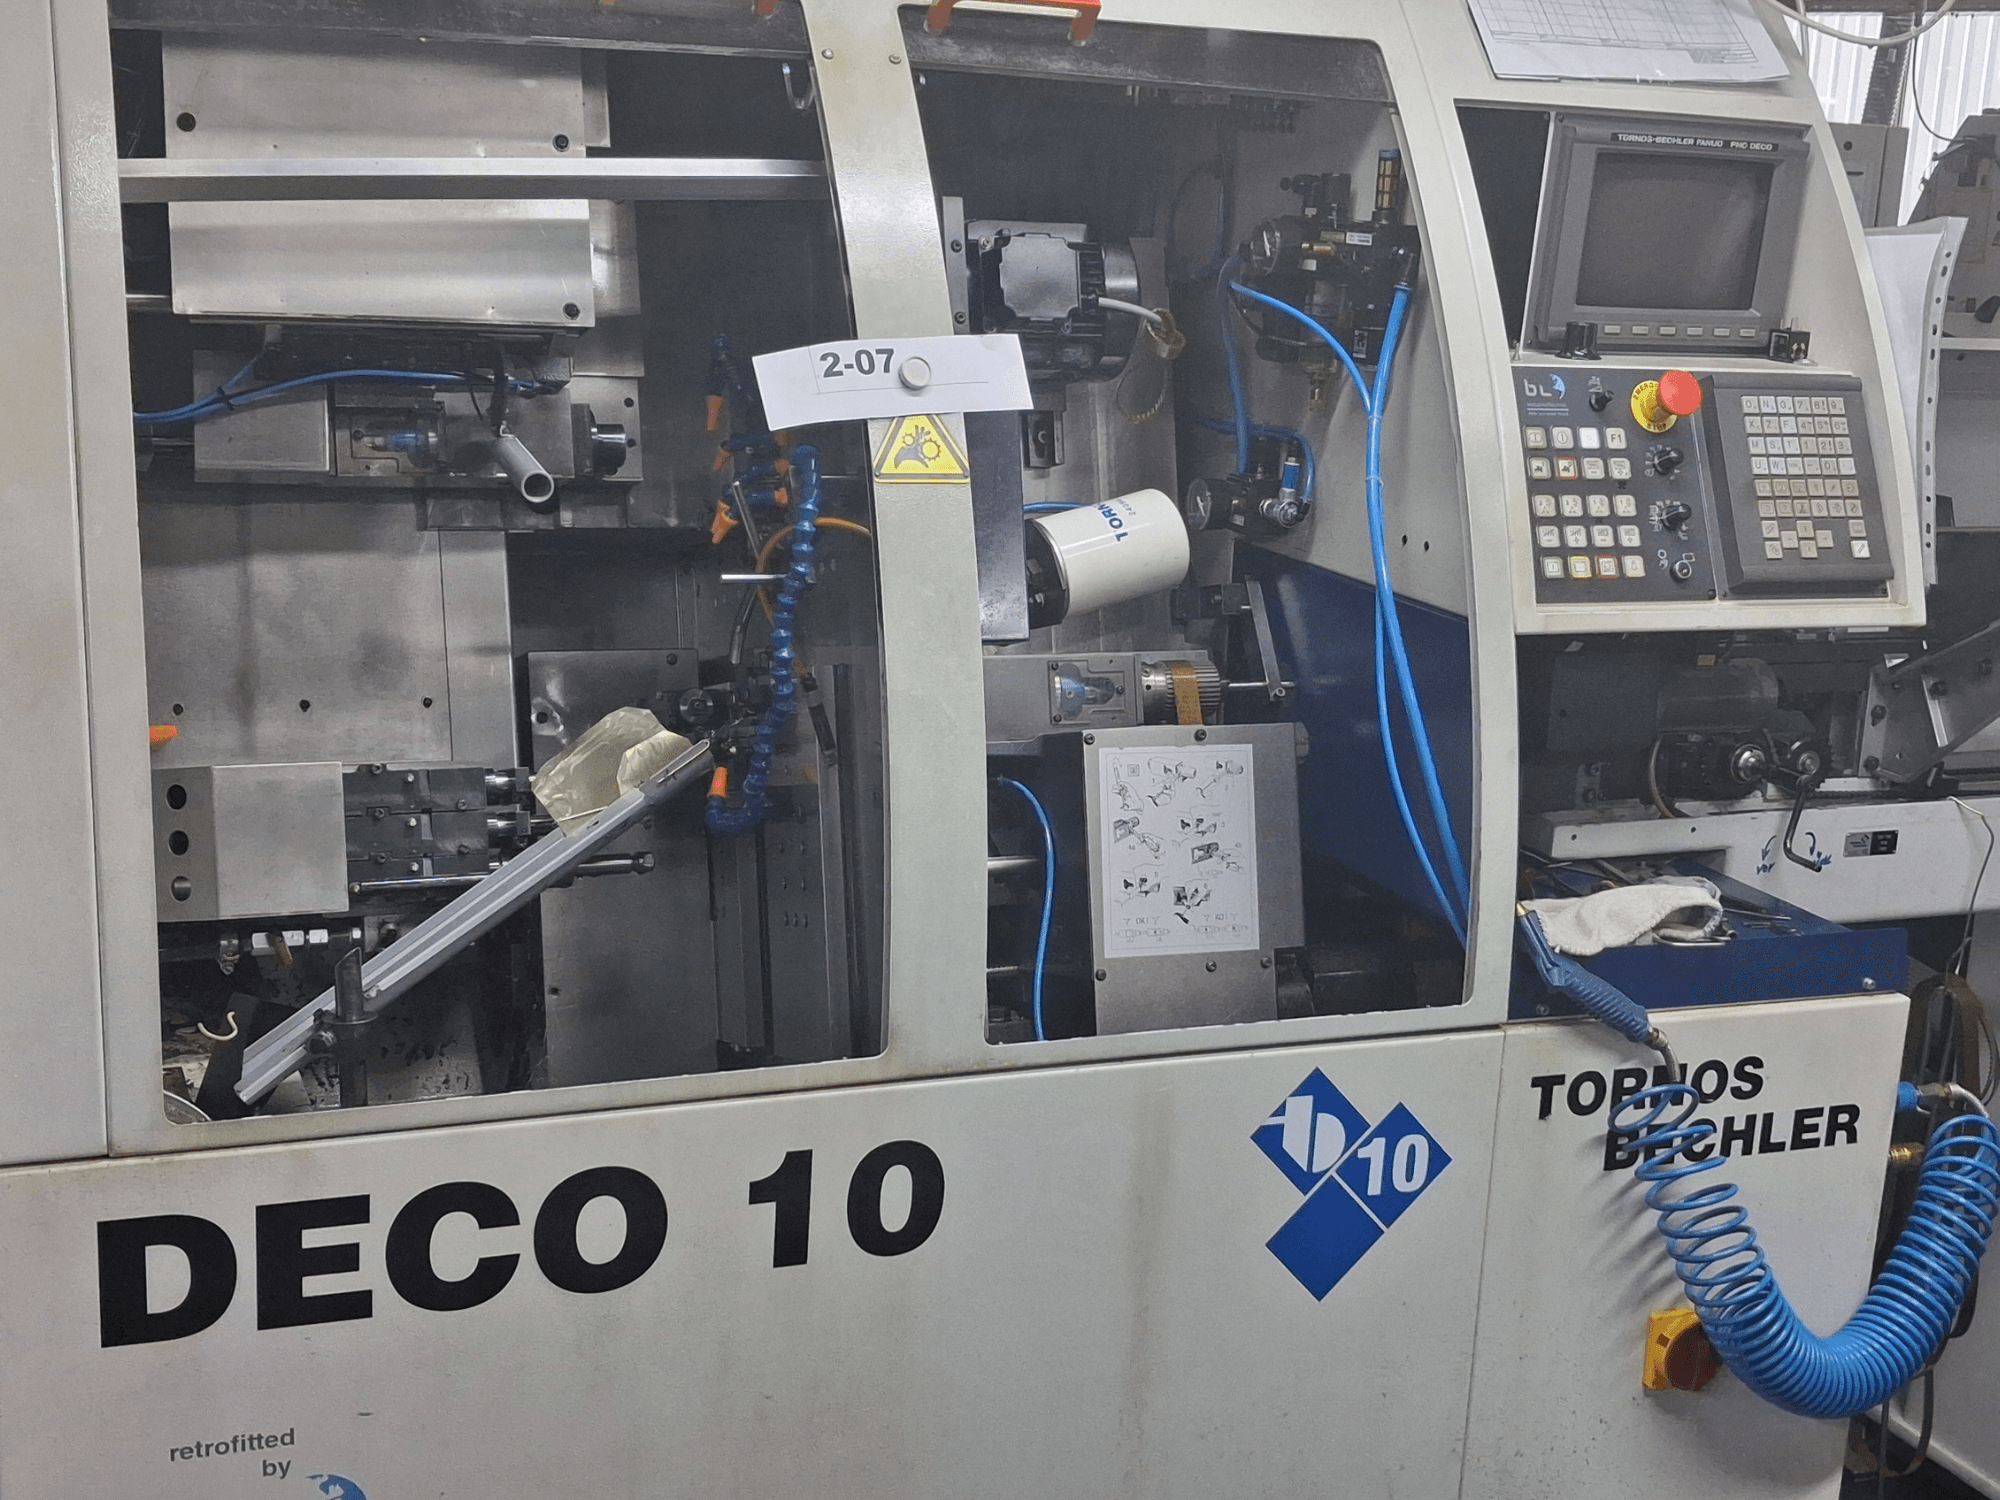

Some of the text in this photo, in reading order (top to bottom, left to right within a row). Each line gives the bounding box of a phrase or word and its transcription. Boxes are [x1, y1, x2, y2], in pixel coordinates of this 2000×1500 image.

[1750, 143, 1773, 151] DECO
[819, 348, 895, 378] 2-07
[1610, 433, 1622, 443] F1
[1093, 503, 1129, 542] TORN
[1530, 1055, 1765, 1121] TORNOS
[1357, 1134, 1430, 1196] 10
[96, 1138, 945, 1349] DECO 10
[169, 1427, 296, 1462] retrofitted
[261, 1458, 292, 1480] by
